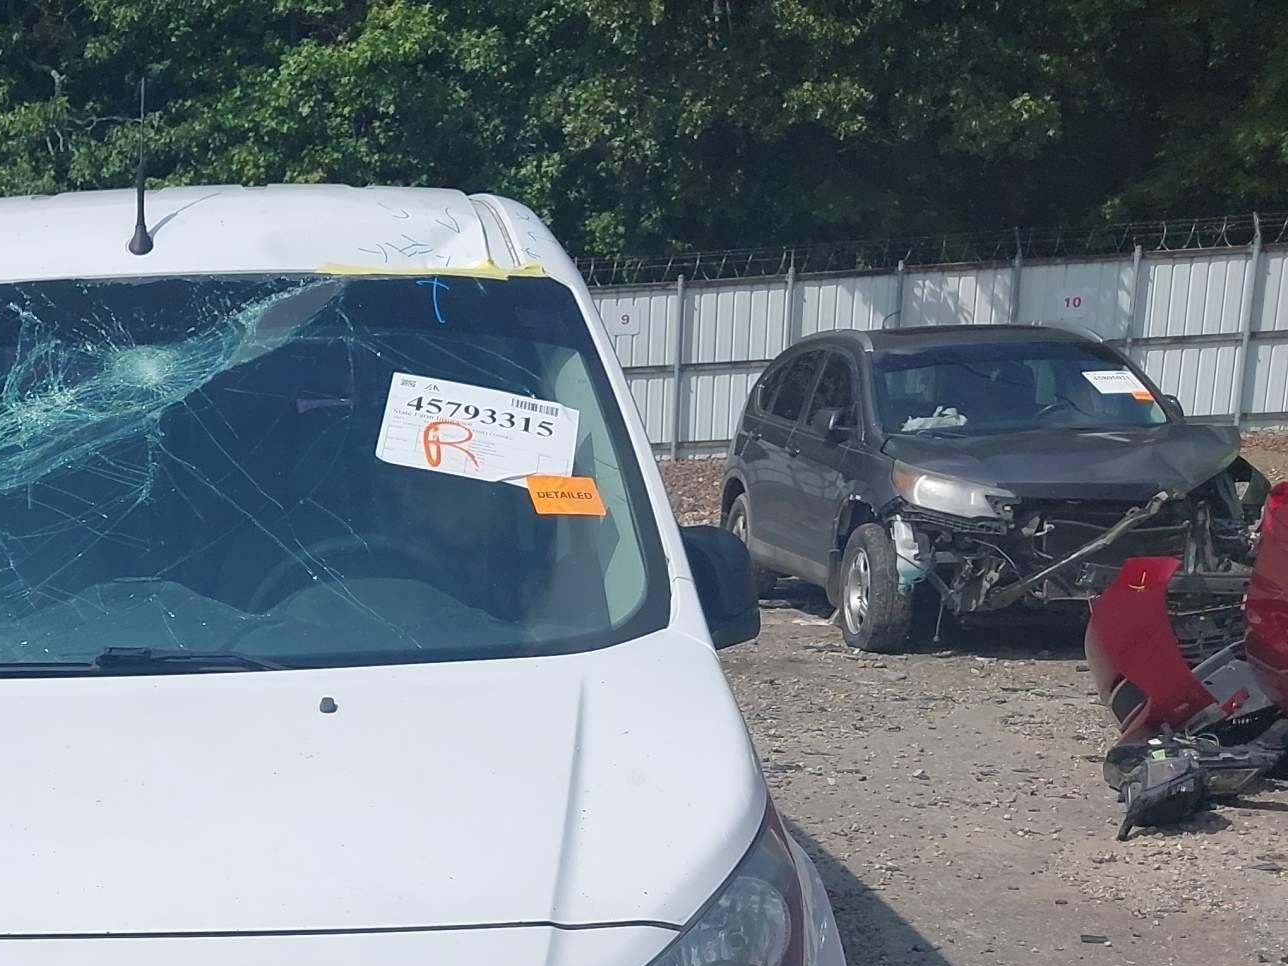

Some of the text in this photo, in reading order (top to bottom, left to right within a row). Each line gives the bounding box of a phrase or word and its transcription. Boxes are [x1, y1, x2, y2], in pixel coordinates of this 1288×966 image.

[1064, 297, 1082, 308] 10
[621, 314, 630, 325] 9
[406, 395, 554, 437] 45793315
[423, 421, 480, 472] R
[536, 490, 593, 500] DETAILED
